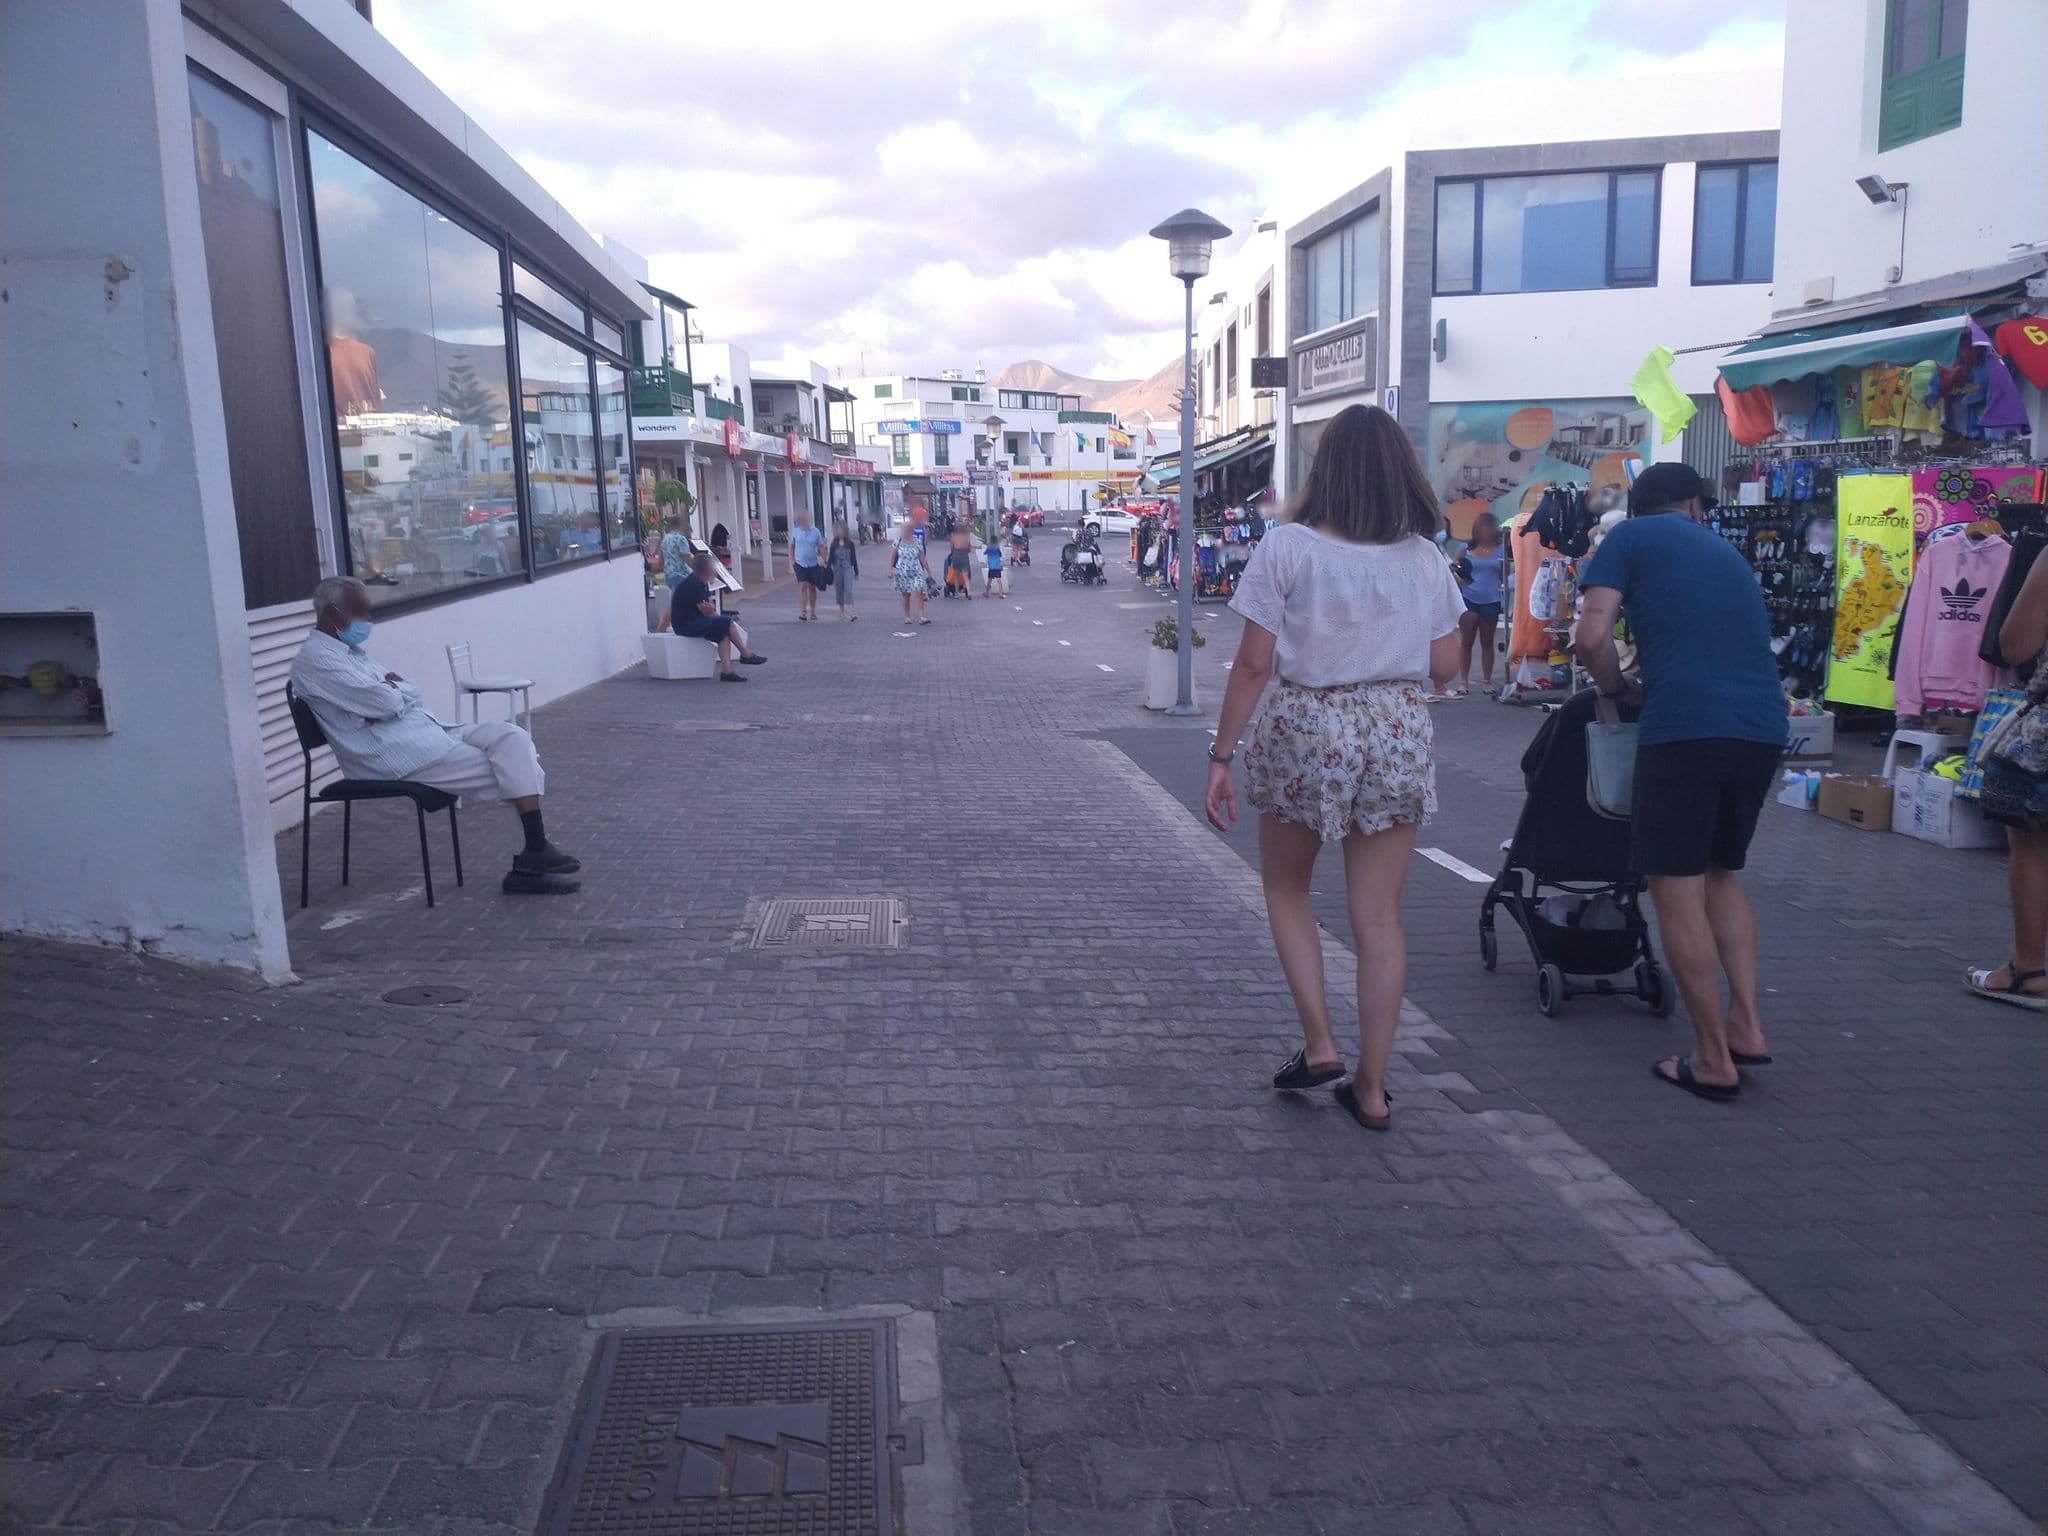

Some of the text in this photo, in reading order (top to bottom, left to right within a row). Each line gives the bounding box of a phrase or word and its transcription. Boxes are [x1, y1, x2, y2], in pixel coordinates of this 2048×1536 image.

[637, 423, 677, 432] wonders
[1848, 512, 1909, 530] Lanzarote
[1938, 610, 1981, 622] adidas
